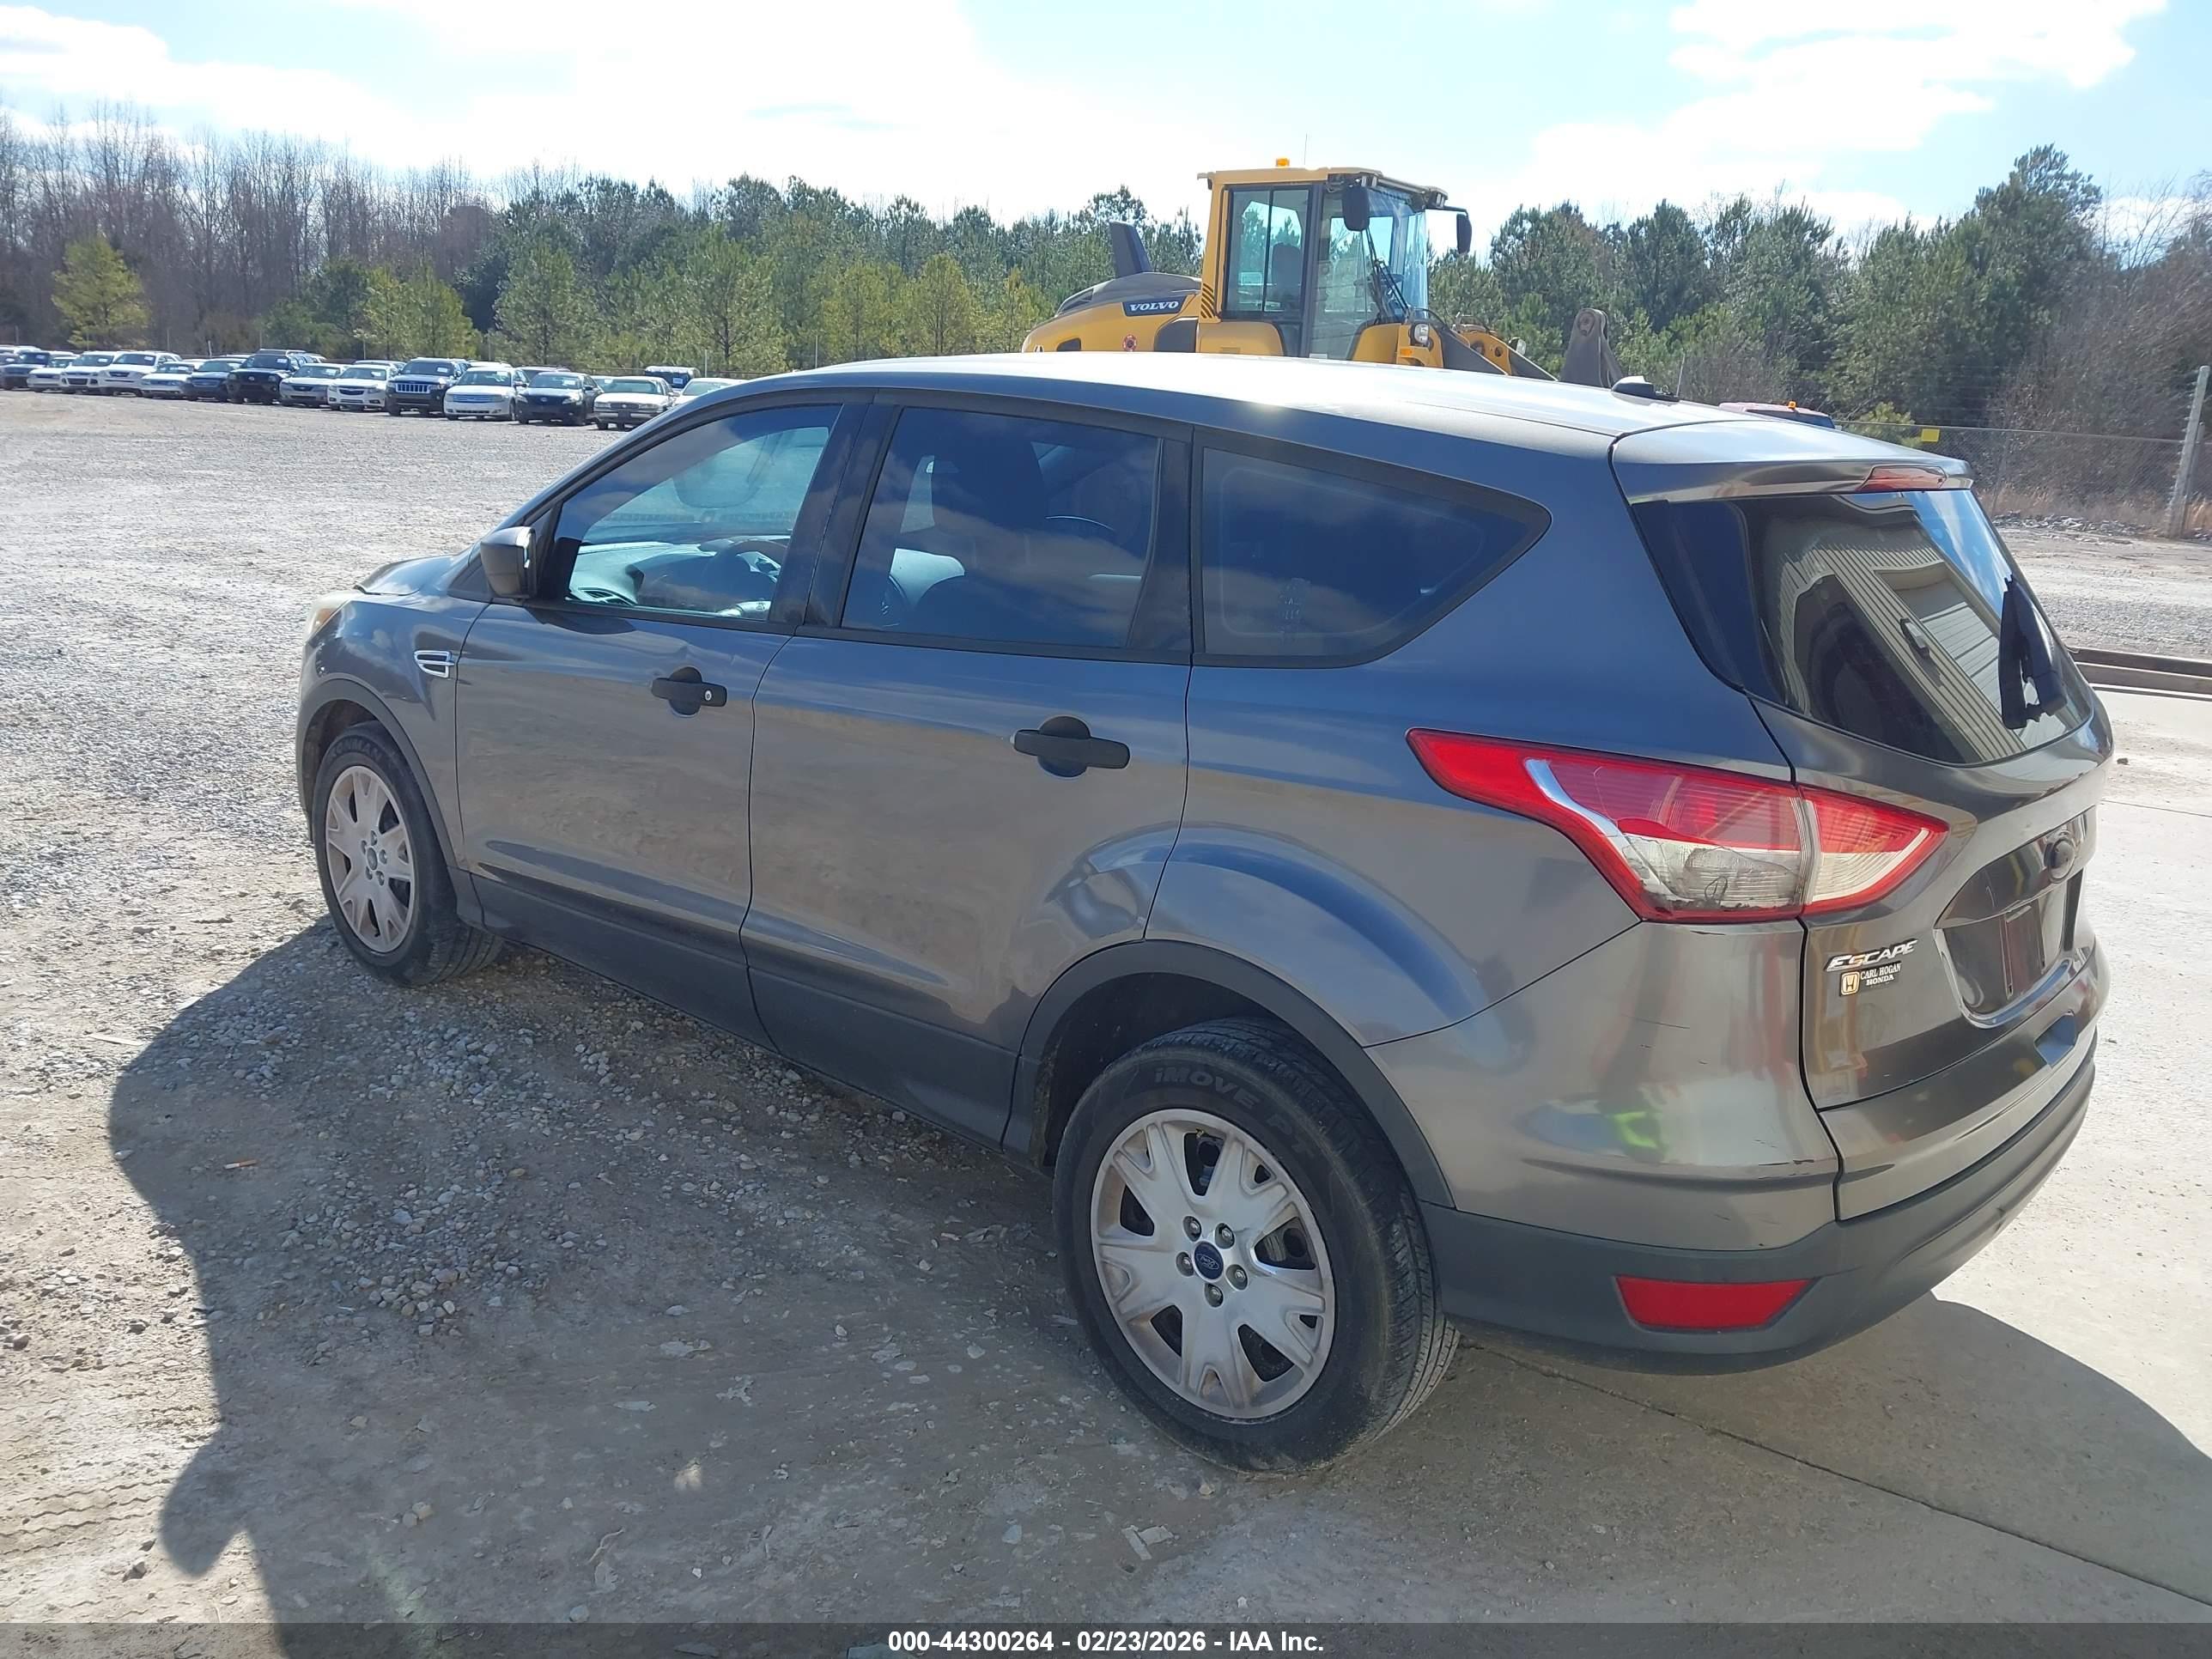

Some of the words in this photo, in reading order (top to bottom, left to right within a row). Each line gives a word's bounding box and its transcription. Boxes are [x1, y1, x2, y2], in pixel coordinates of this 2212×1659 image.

[1129, 301, 1179, 312] VOLVO
[1826, 939, 1918, 972] ESCAPE
[1860, 969, 1879, 980] CARL
[1879, 963, 1902, 977] HOGAN
[1866, 974, 1894, 986] HONDA
